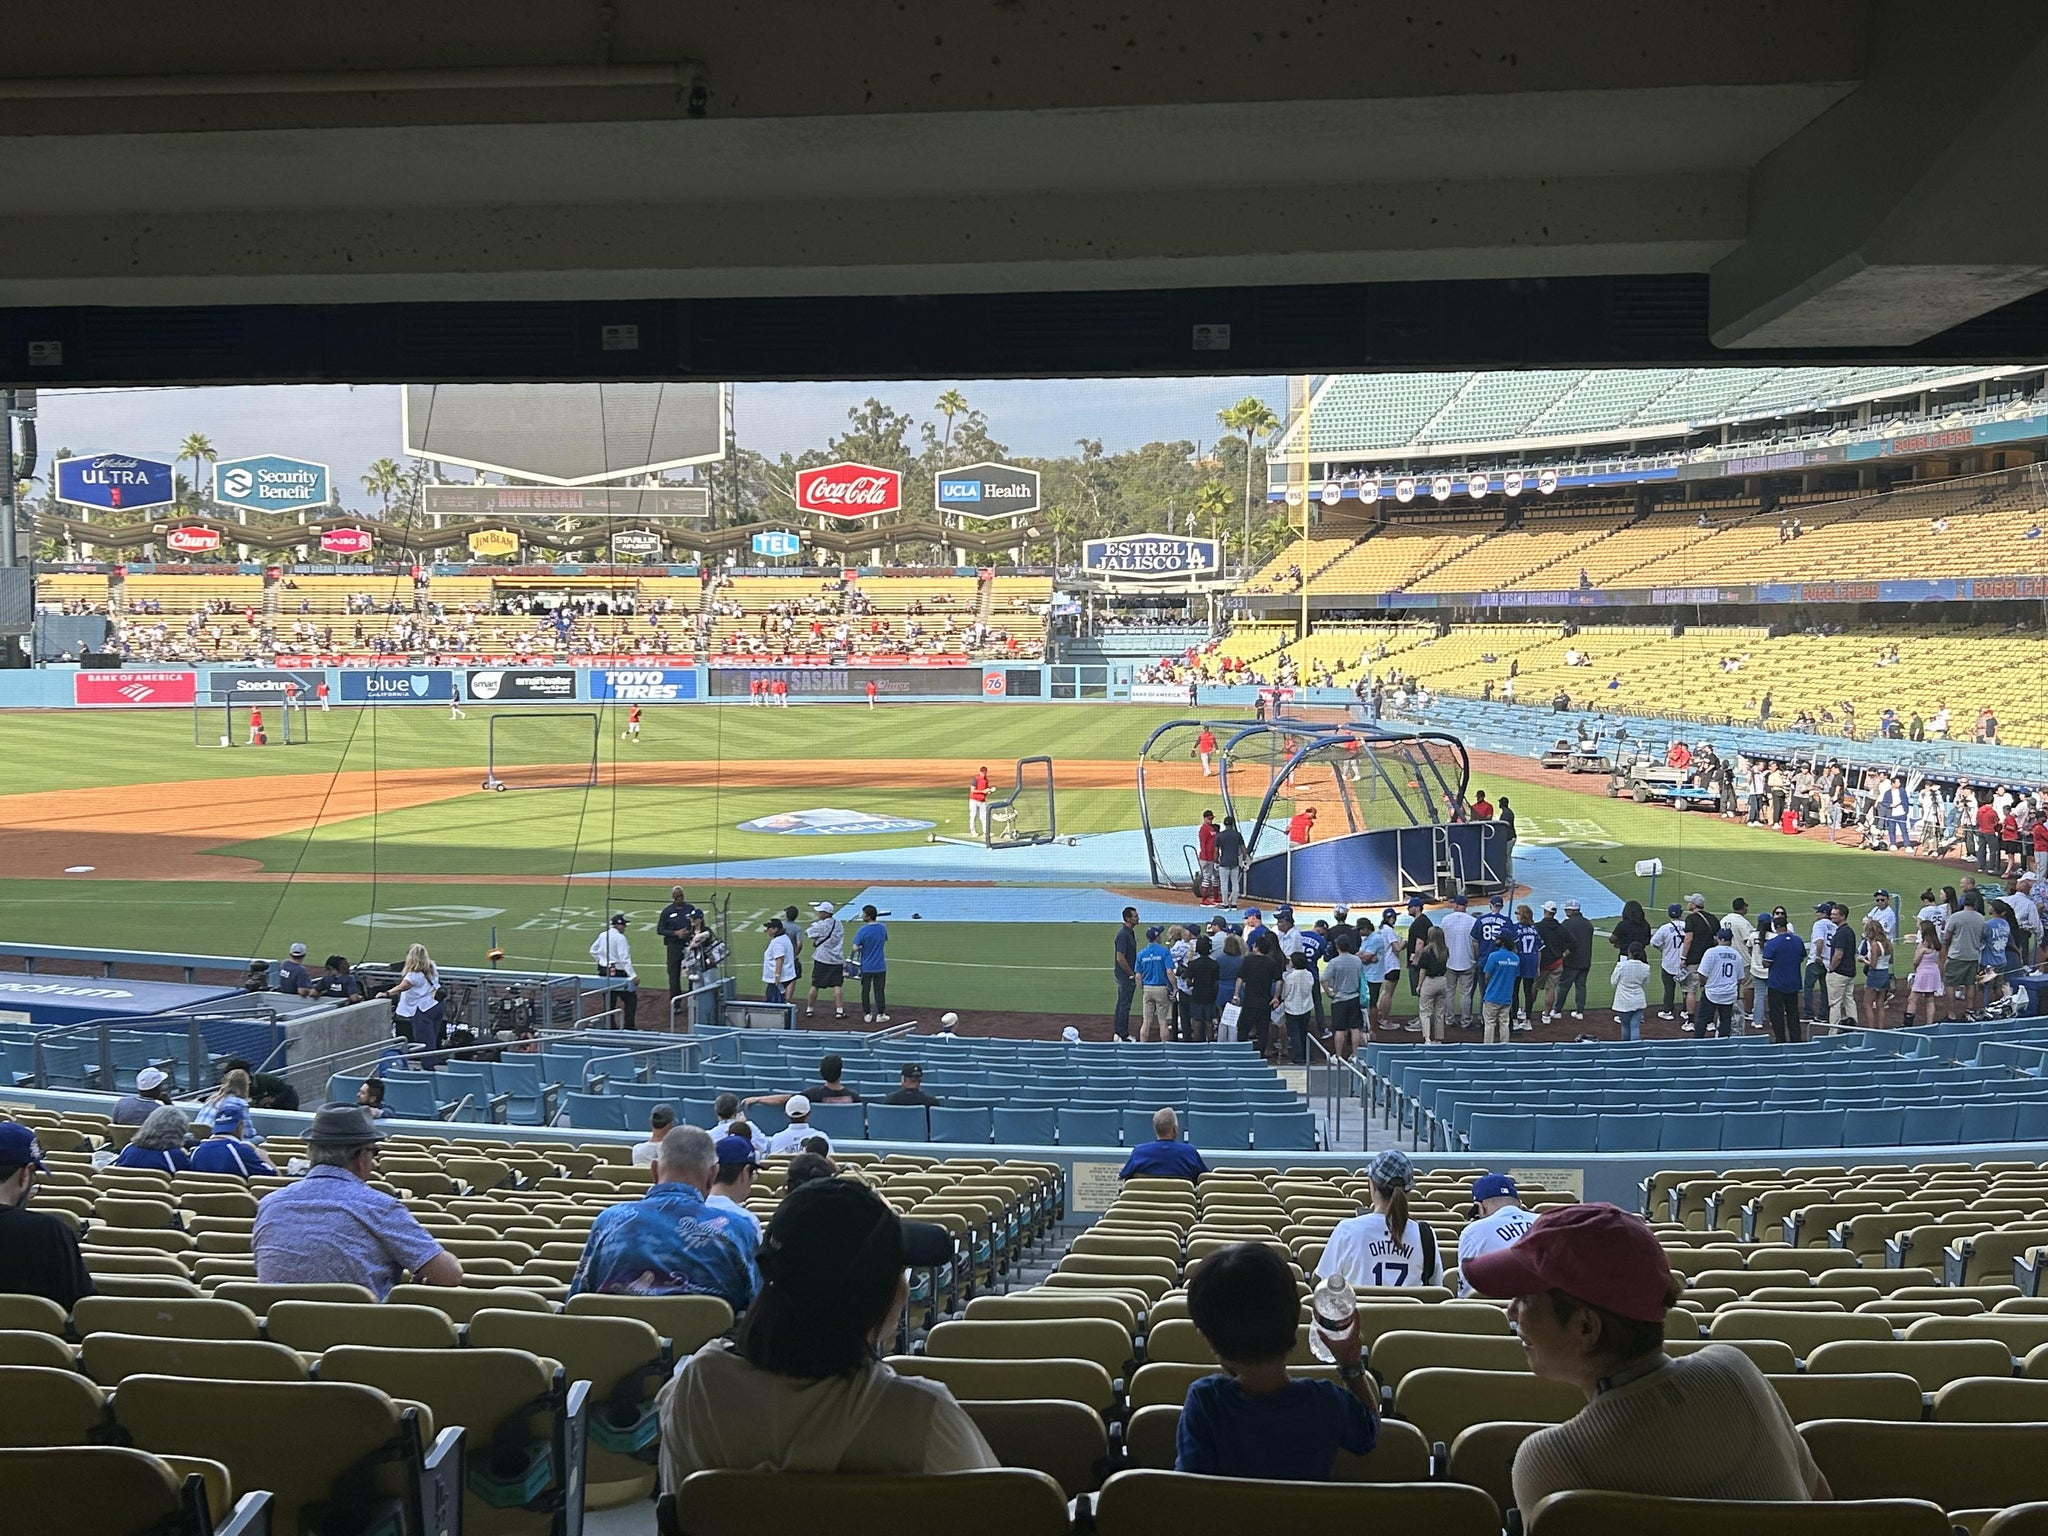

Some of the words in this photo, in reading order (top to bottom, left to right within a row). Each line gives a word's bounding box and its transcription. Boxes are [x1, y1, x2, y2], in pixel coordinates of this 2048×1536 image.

[82, 469, 149, 485] ULTRA
[257, 469, 318, 486] Security
[258, 484, 311, 499] Benefit
[806, 476, 891, 505] Coca-Cola
[944, 485, 977, 497] UCLA
[984, 483, 1031, 498] Health
[533, 491, 583, 508] SASAKI
[168, 531, 217, 547] Churu
[473, 534, 493, 550] JIM
[494, 532, 514, 548] BEAM
[615, 537, 658, 545] STARLUX
[758, 536, 794, 552] TEL
[1096, 556, 1181, 570] JALISCO
[134, 673, 183, 681] AMERICA
[366, 675, 409, 692] blue
[605, 671, 663, 685] TOYO
[791, 671, 849, 691] SASAKI
[988, 678, 1002, 690] 76
[615, 685, 677, 699] TIRES
[1522, 935, 1535, 953] 17
[1673, 935, 1685, 949] 17
[1722, 963, 1734, 978] 10
[1496, 1221, 1534, 1242] OHTA
[1369, 1240, 1414, 1260] OHTANI
[1372, 1262, 1409, 1287] 17
